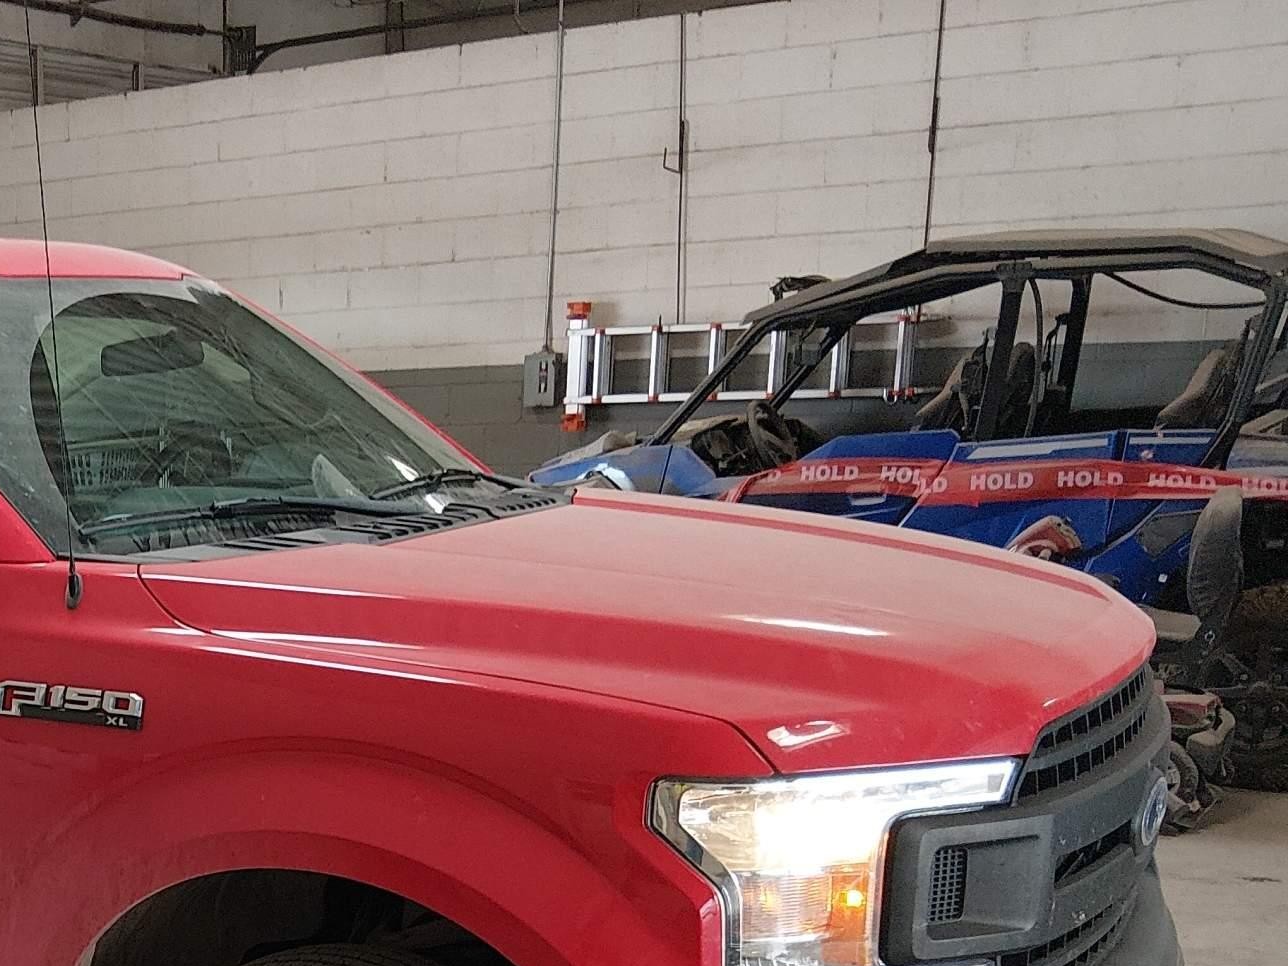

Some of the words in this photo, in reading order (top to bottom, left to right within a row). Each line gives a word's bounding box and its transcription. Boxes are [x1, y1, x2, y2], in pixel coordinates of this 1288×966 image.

[800, 465, 859, 482] HOLD
[970, 471, 1034, 491] HOLD
[1057, 470, 1124, 488] HOLD
[1148, 473, 1217, 490] HOLD
[106, 717, 128, 727] XL
